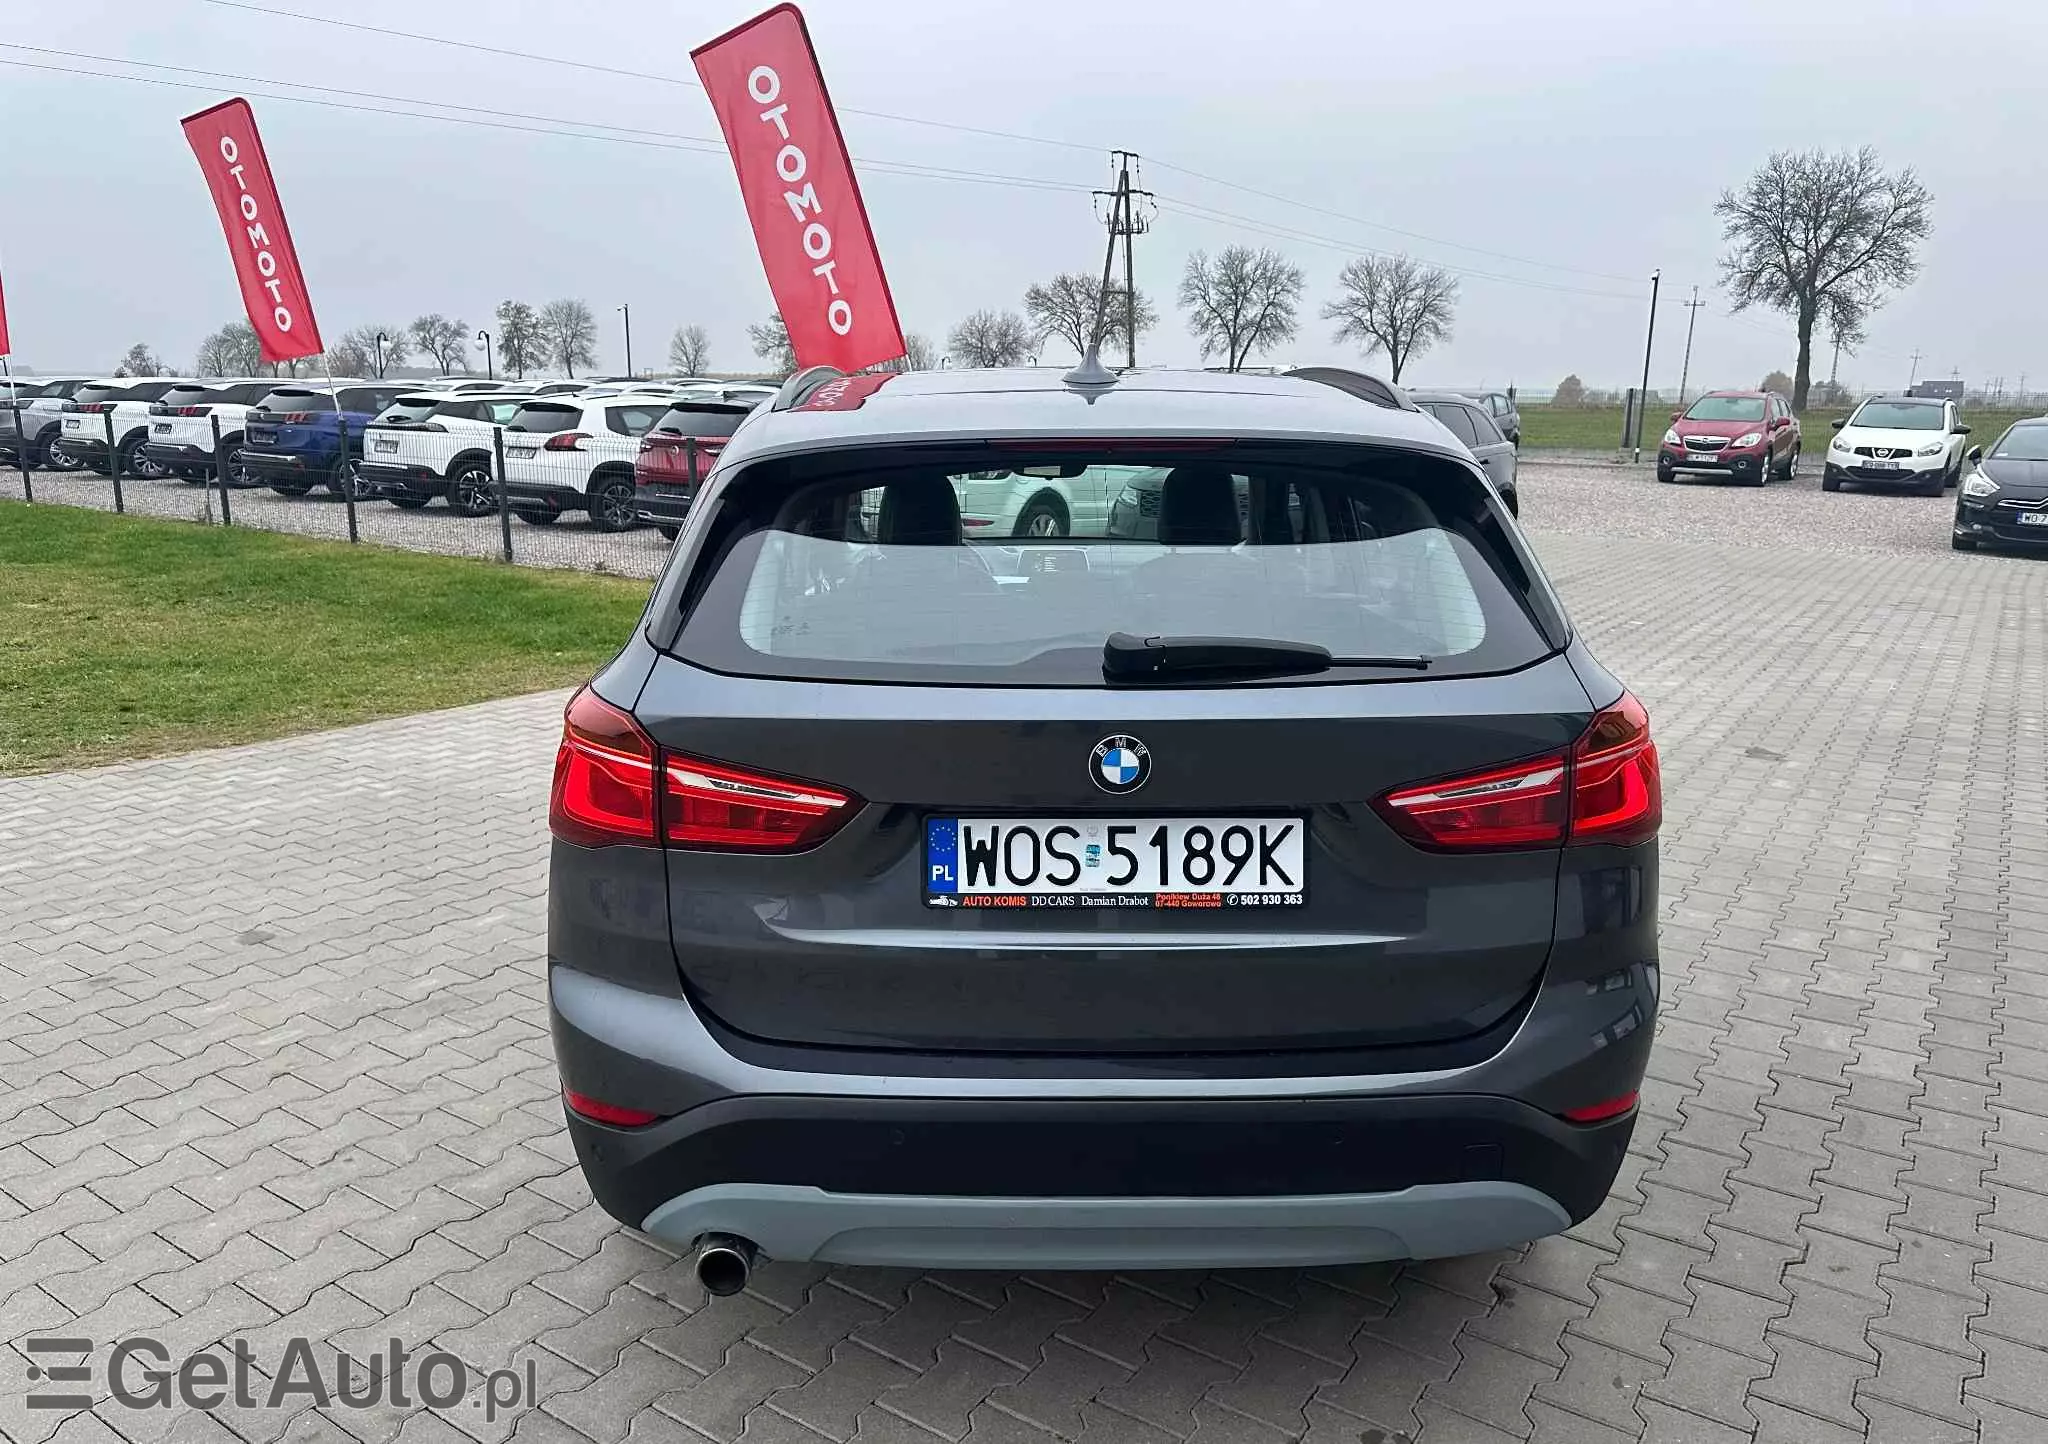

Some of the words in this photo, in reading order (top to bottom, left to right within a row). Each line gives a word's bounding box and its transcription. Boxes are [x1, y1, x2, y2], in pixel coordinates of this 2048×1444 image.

[747, 65, 852, 336] OTOMOTO
[220, 135, 292, 332] OTOMOTO
[1096, 737, 1147, 757] BMW
[963, 825, 1082, 887] WOS
[1106, 824, 1295, 887] 5189K
[932, 865, 954, 881] PL
[963, 895, 993, 906] AUTO
[994, 895, 1027, 906] KOMIS
[1031, 895, 1047, 906] DD
[1048, 895, 1075, 906] CARS
[1081, 895, 1116, 906] Damian
[1118, 895, 1149, 906] Drabot
[1240, 895, 1260, 905] 502
[1262, 895, 1281, 905] 930
[1283, 895, 1303, 905] 363
